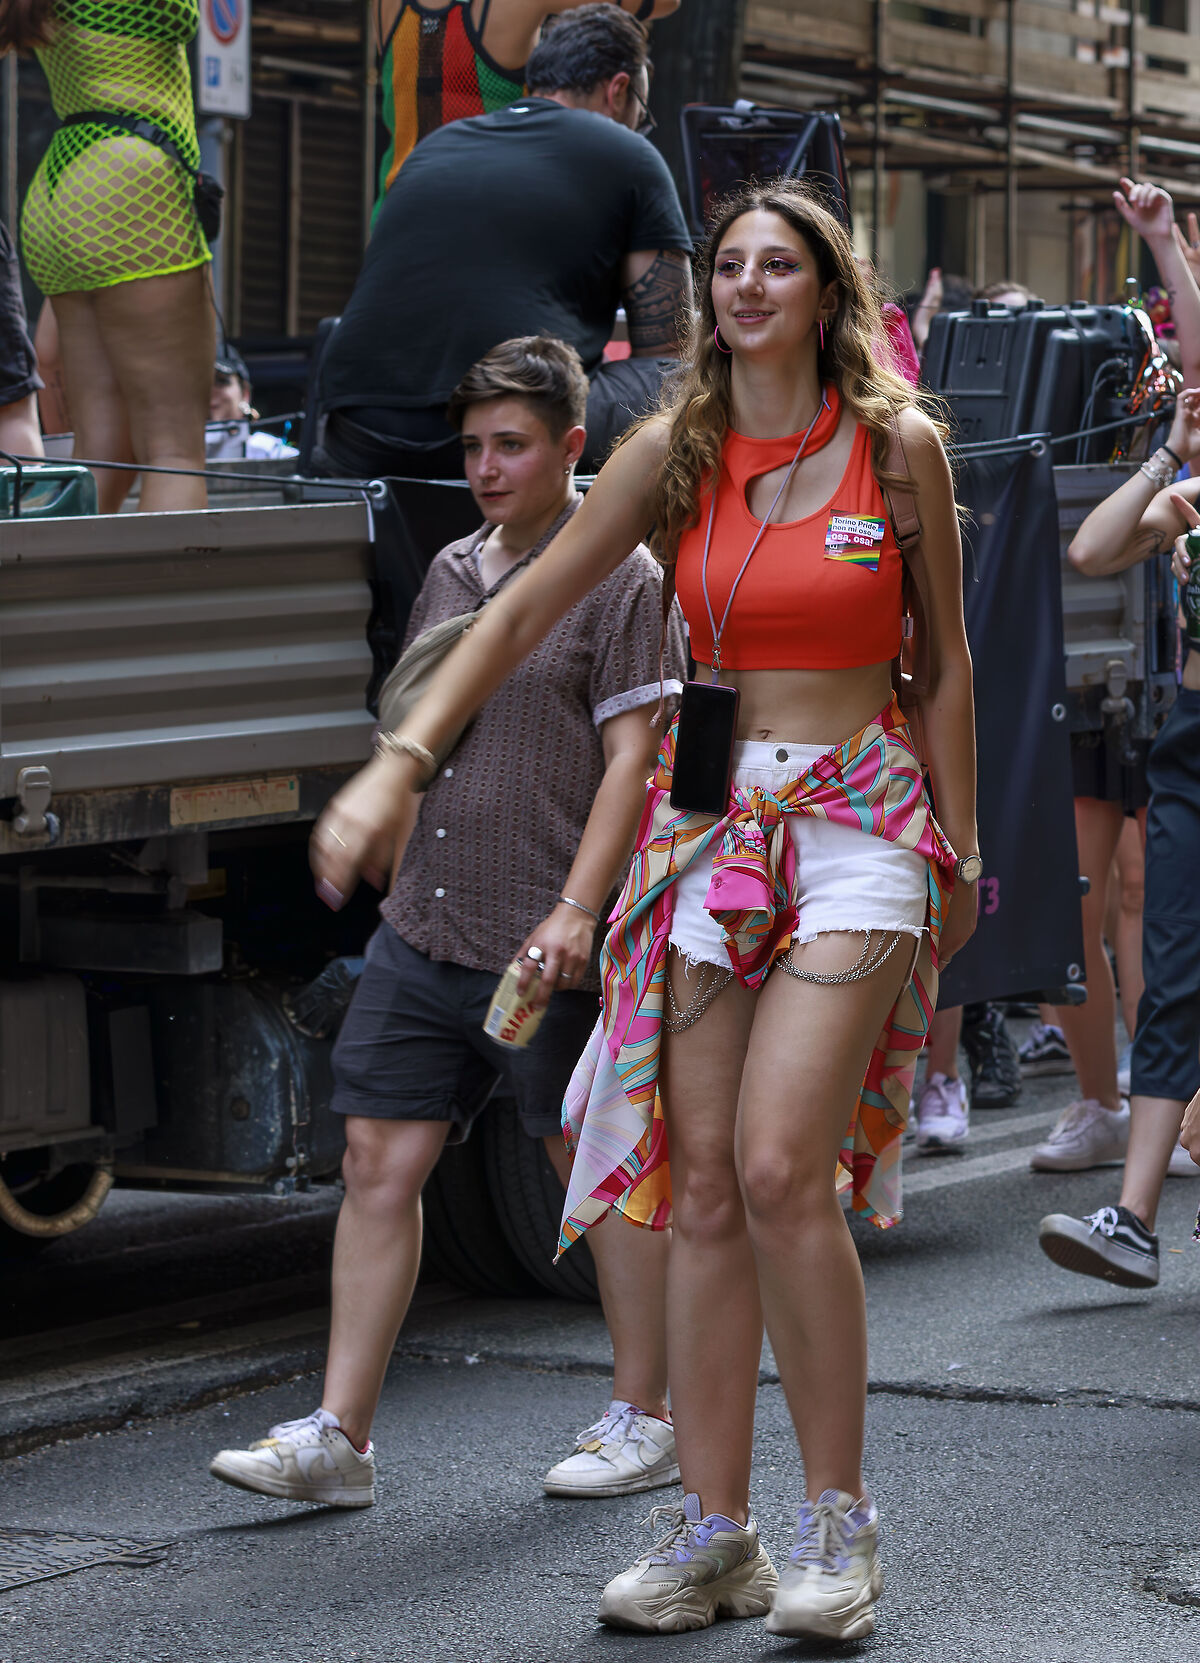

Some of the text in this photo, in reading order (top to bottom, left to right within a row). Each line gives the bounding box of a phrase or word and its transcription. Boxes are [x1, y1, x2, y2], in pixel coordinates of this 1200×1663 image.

[833, 517, 857, 526] Torino
[831, 533, 874, 547] osa, osa!
